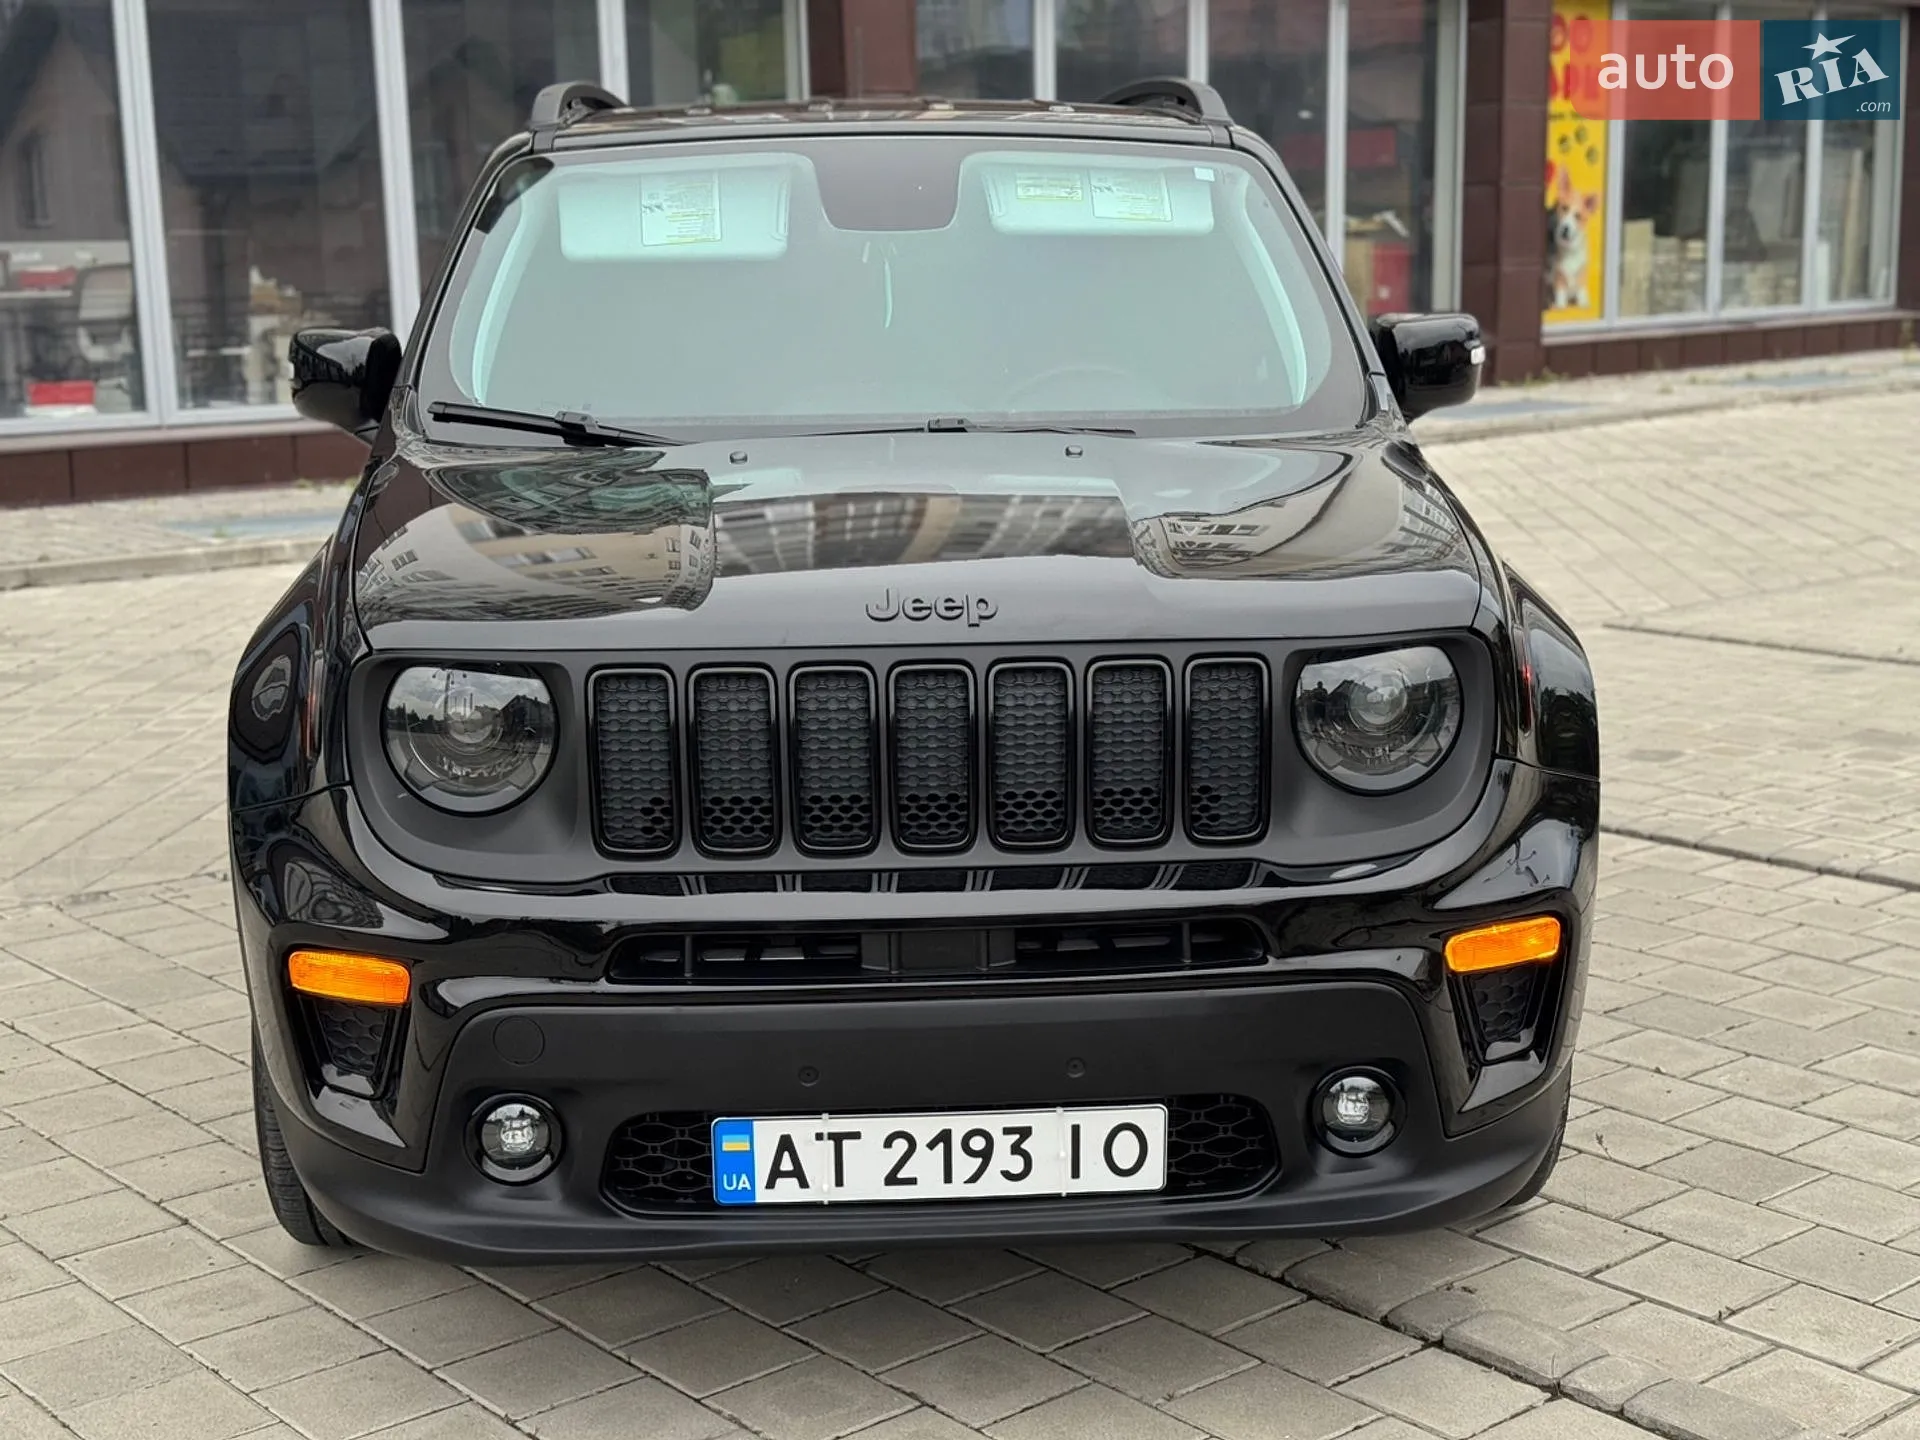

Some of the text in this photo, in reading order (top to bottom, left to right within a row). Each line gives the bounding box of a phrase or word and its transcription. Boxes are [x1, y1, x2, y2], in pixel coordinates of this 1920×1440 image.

[865, 587, 999, 628] Jeep
[764, 1121, 1149, 1190] AT 2193 IO
[722, 1172, 752, 1191] UA
